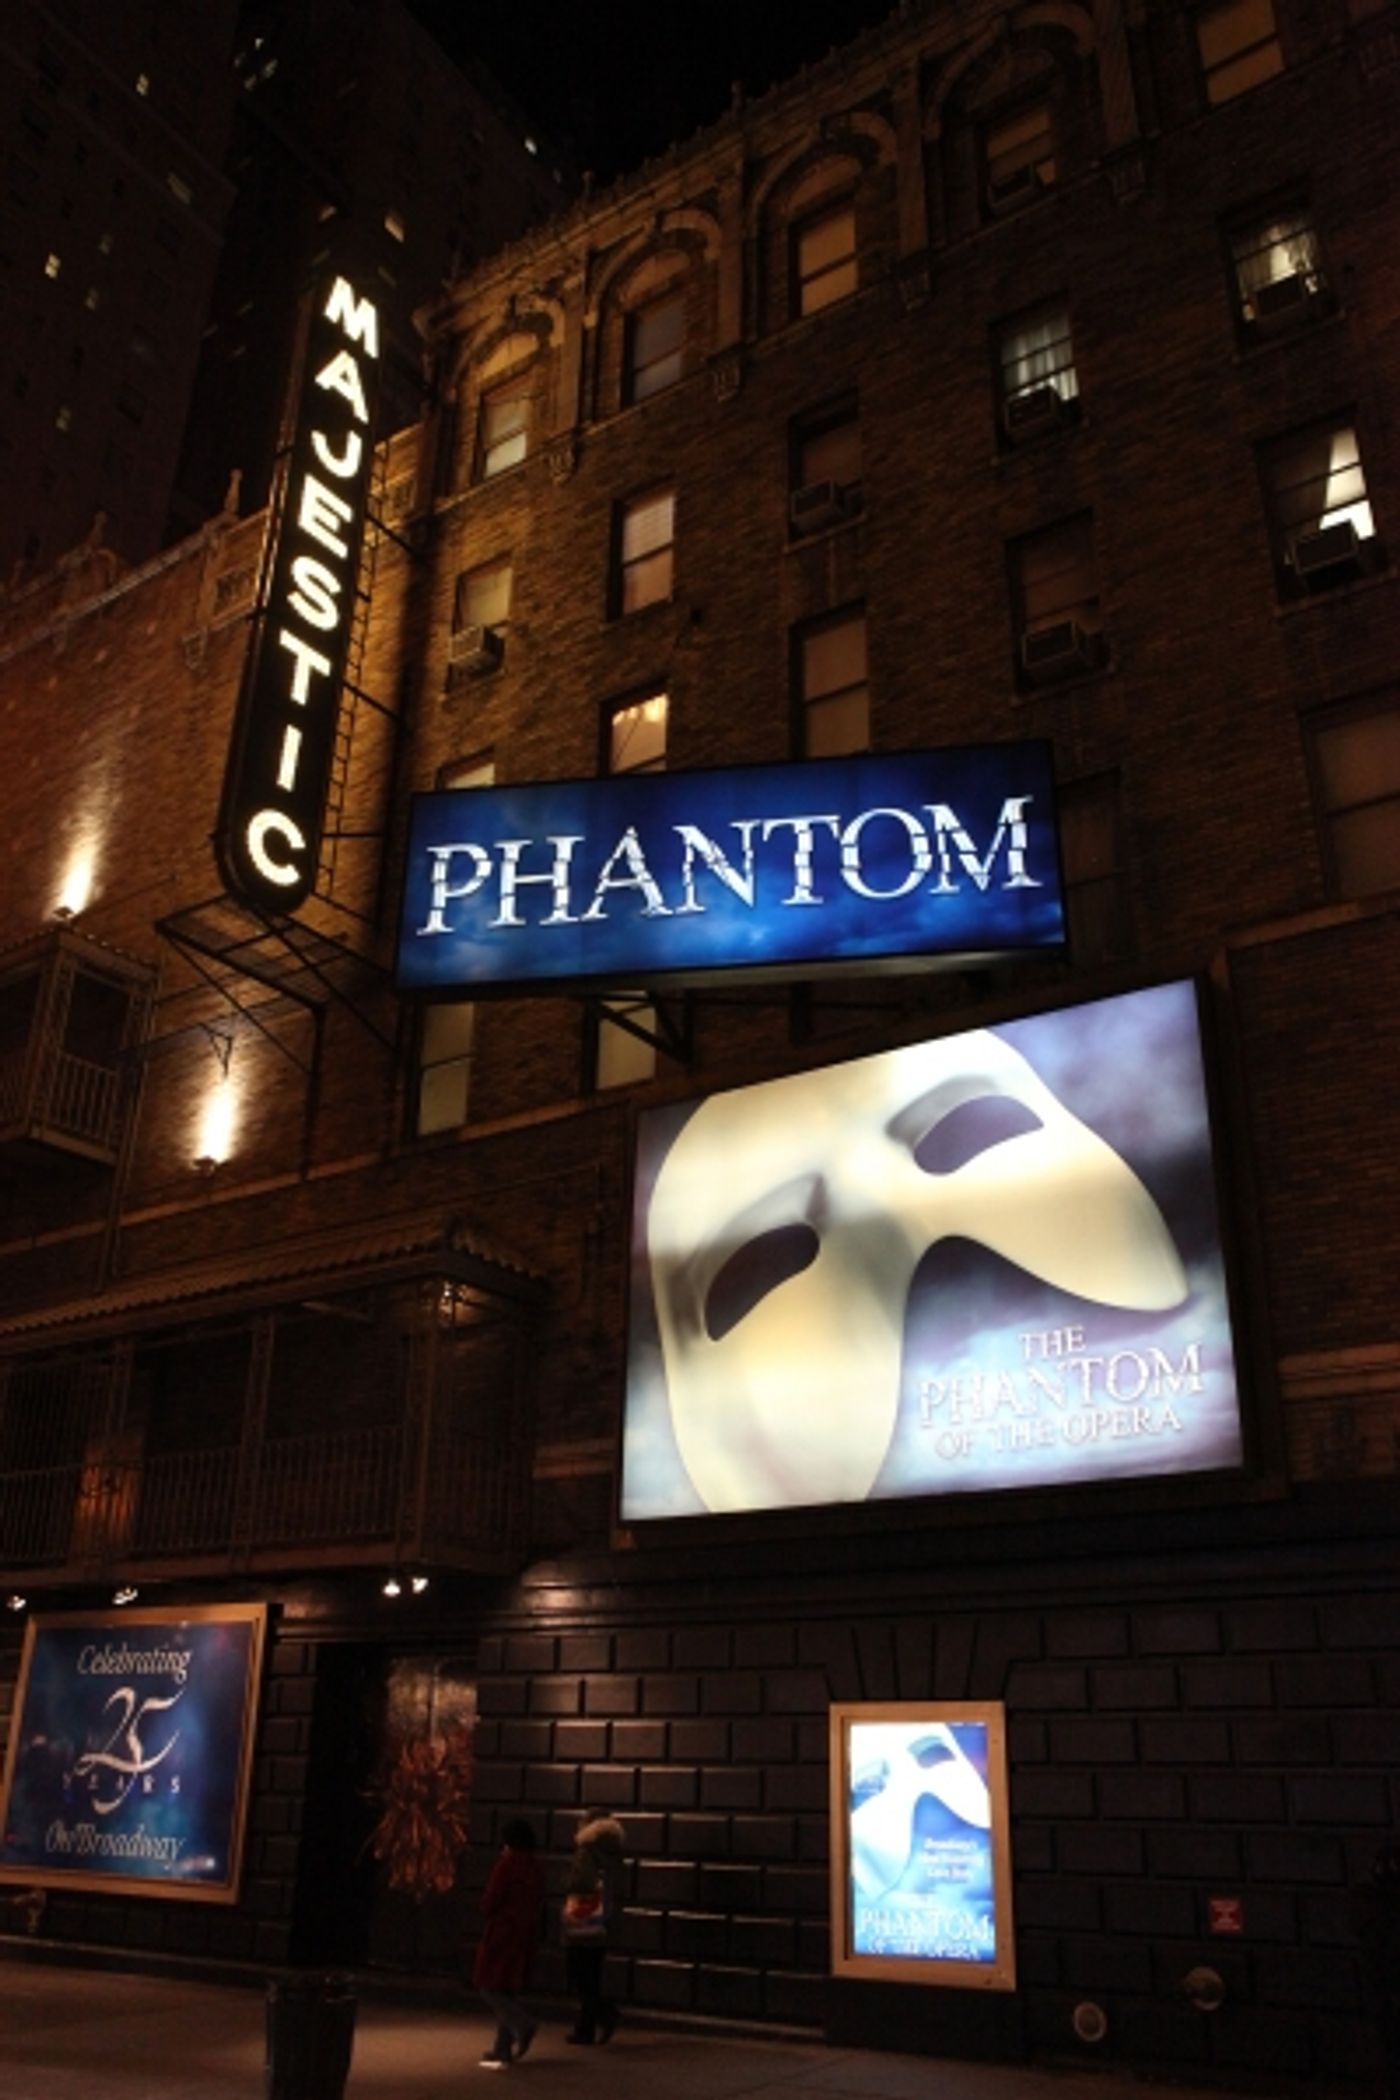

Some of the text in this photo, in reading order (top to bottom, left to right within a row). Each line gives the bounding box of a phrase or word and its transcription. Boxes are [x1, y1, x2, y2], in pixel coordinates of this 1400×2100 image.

[246, 275, 378, 887] MAJESTIC
[416, 795, 1043, 935] PHANTOM
[1019, 1324, 1087, 1361] THE
[919, 1341, 1208, 1429] PHANTOM
[935, 1404, 1184, 1461] OF THE OPERA
[78, 1643, 191, 1684] Celebrating
[74, 1686, 184, 1813] 25
[73, 1823, 185, 1868] Broadway
[861, 1906, 990, 1940] PHANTOM
